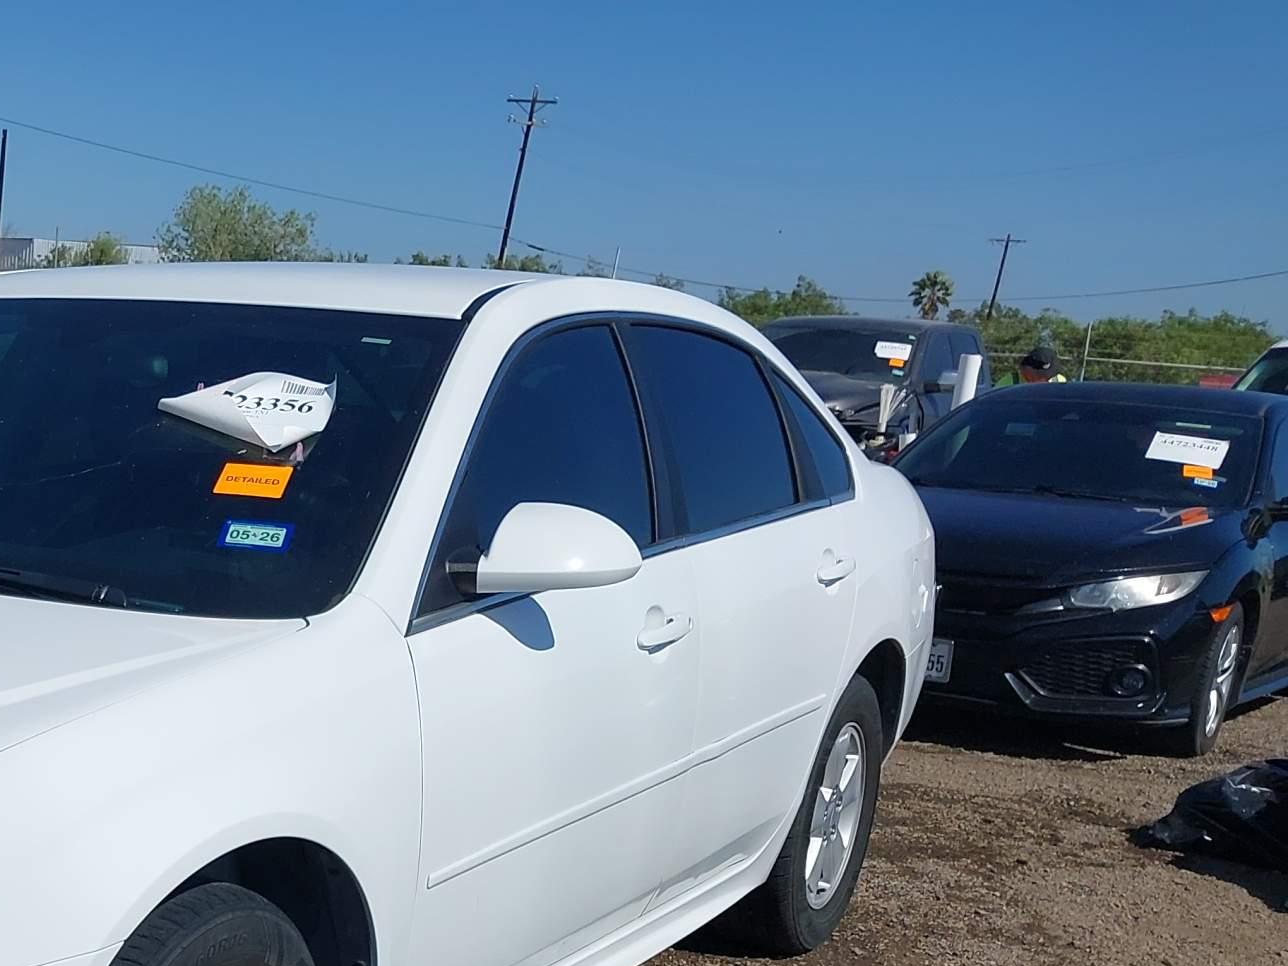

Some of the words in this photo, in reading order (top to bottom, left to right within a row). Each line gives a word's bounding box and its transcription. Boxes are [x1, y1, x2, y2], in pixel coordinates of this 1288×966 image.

[225, 475, 280, 486] DETAILED
[229, 529, 252, 540] 05
[258, 531, 282, 543] 26
